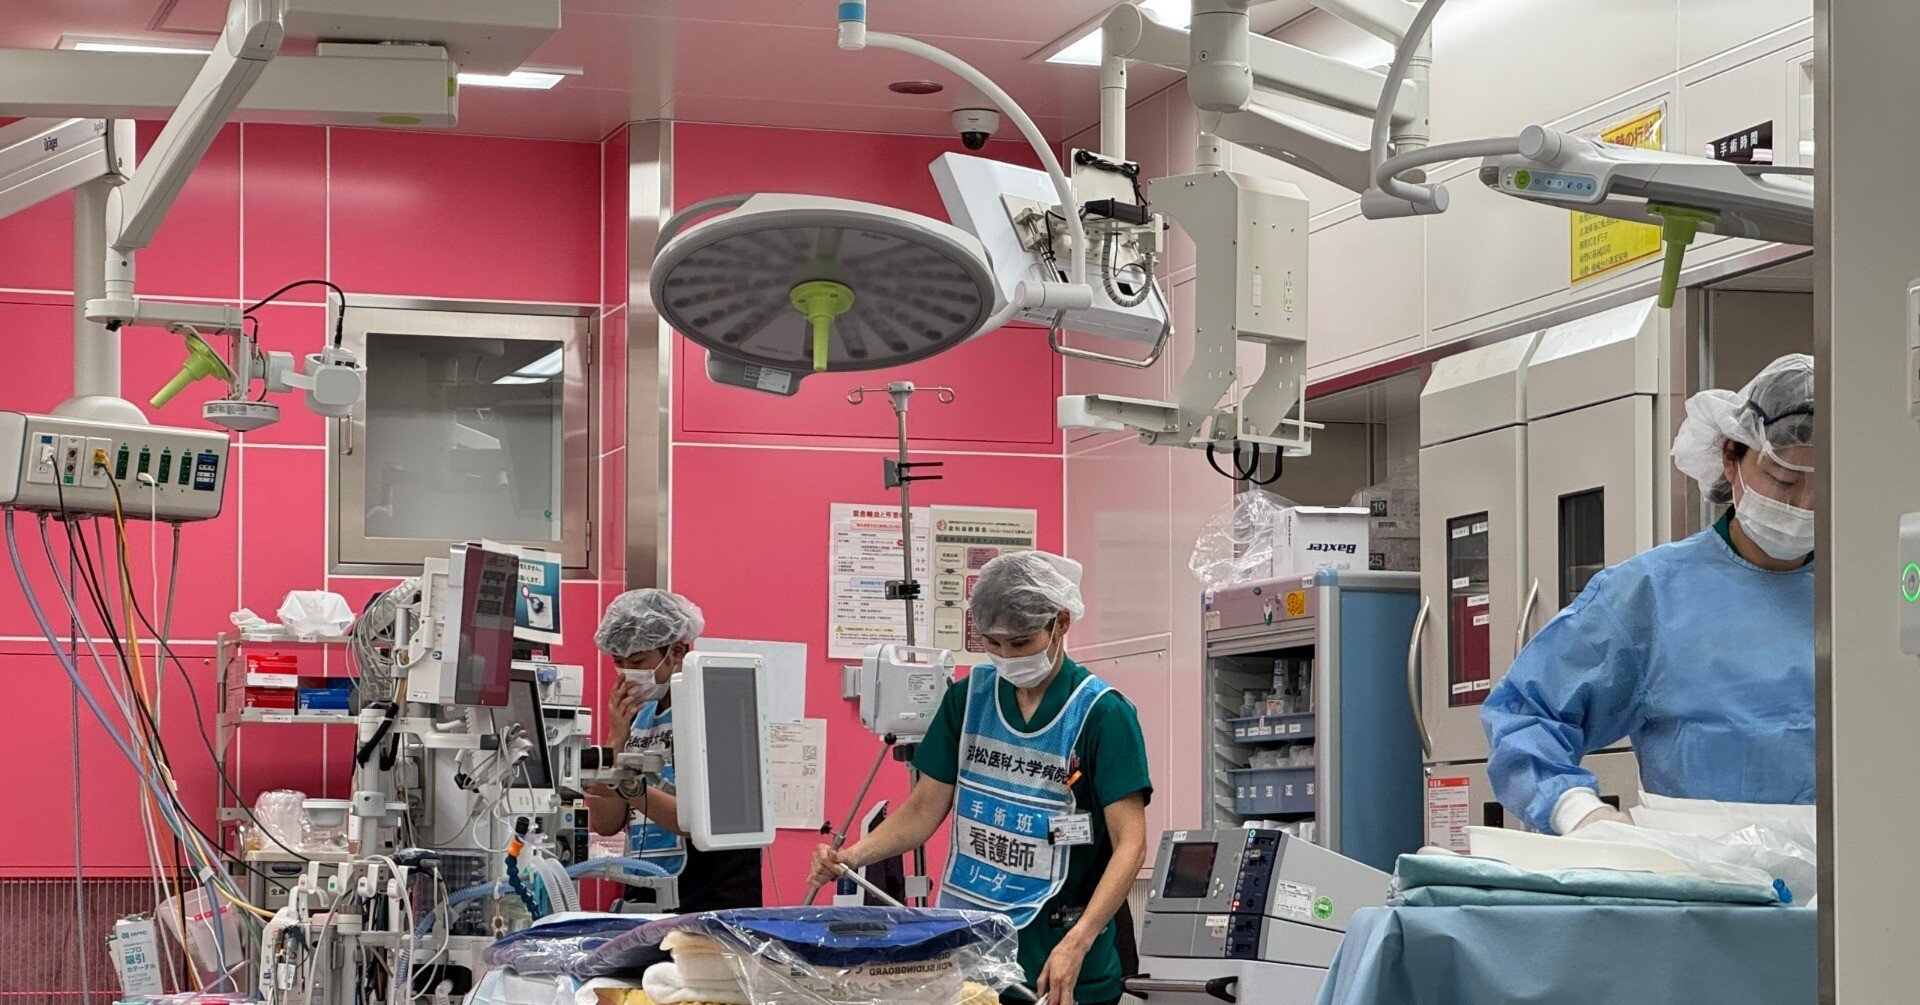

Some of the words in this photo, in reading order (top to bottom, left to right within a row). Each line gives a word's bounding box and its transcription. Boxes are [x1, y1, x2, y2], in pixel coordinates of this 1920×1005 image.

[1720, 130, 1759, 157] 手術時間
[1373, 501, 1385, 511] 10
[853, 509, 913, 520] 緊急輸血と所要間
[1306, 542, 1357, 554] Baxter
[1369, 554, 1383, 566] 25
[971, 800, 1033, 833] 手術班
[969, 826, 1037, 872] 看護師
[969, 864, 1026, 892] リーダー
[124, 946, 142, 955] ニプロ
[125, 953, 146, 965] 吸引
[127, 962, 156, 973] カテーテル
